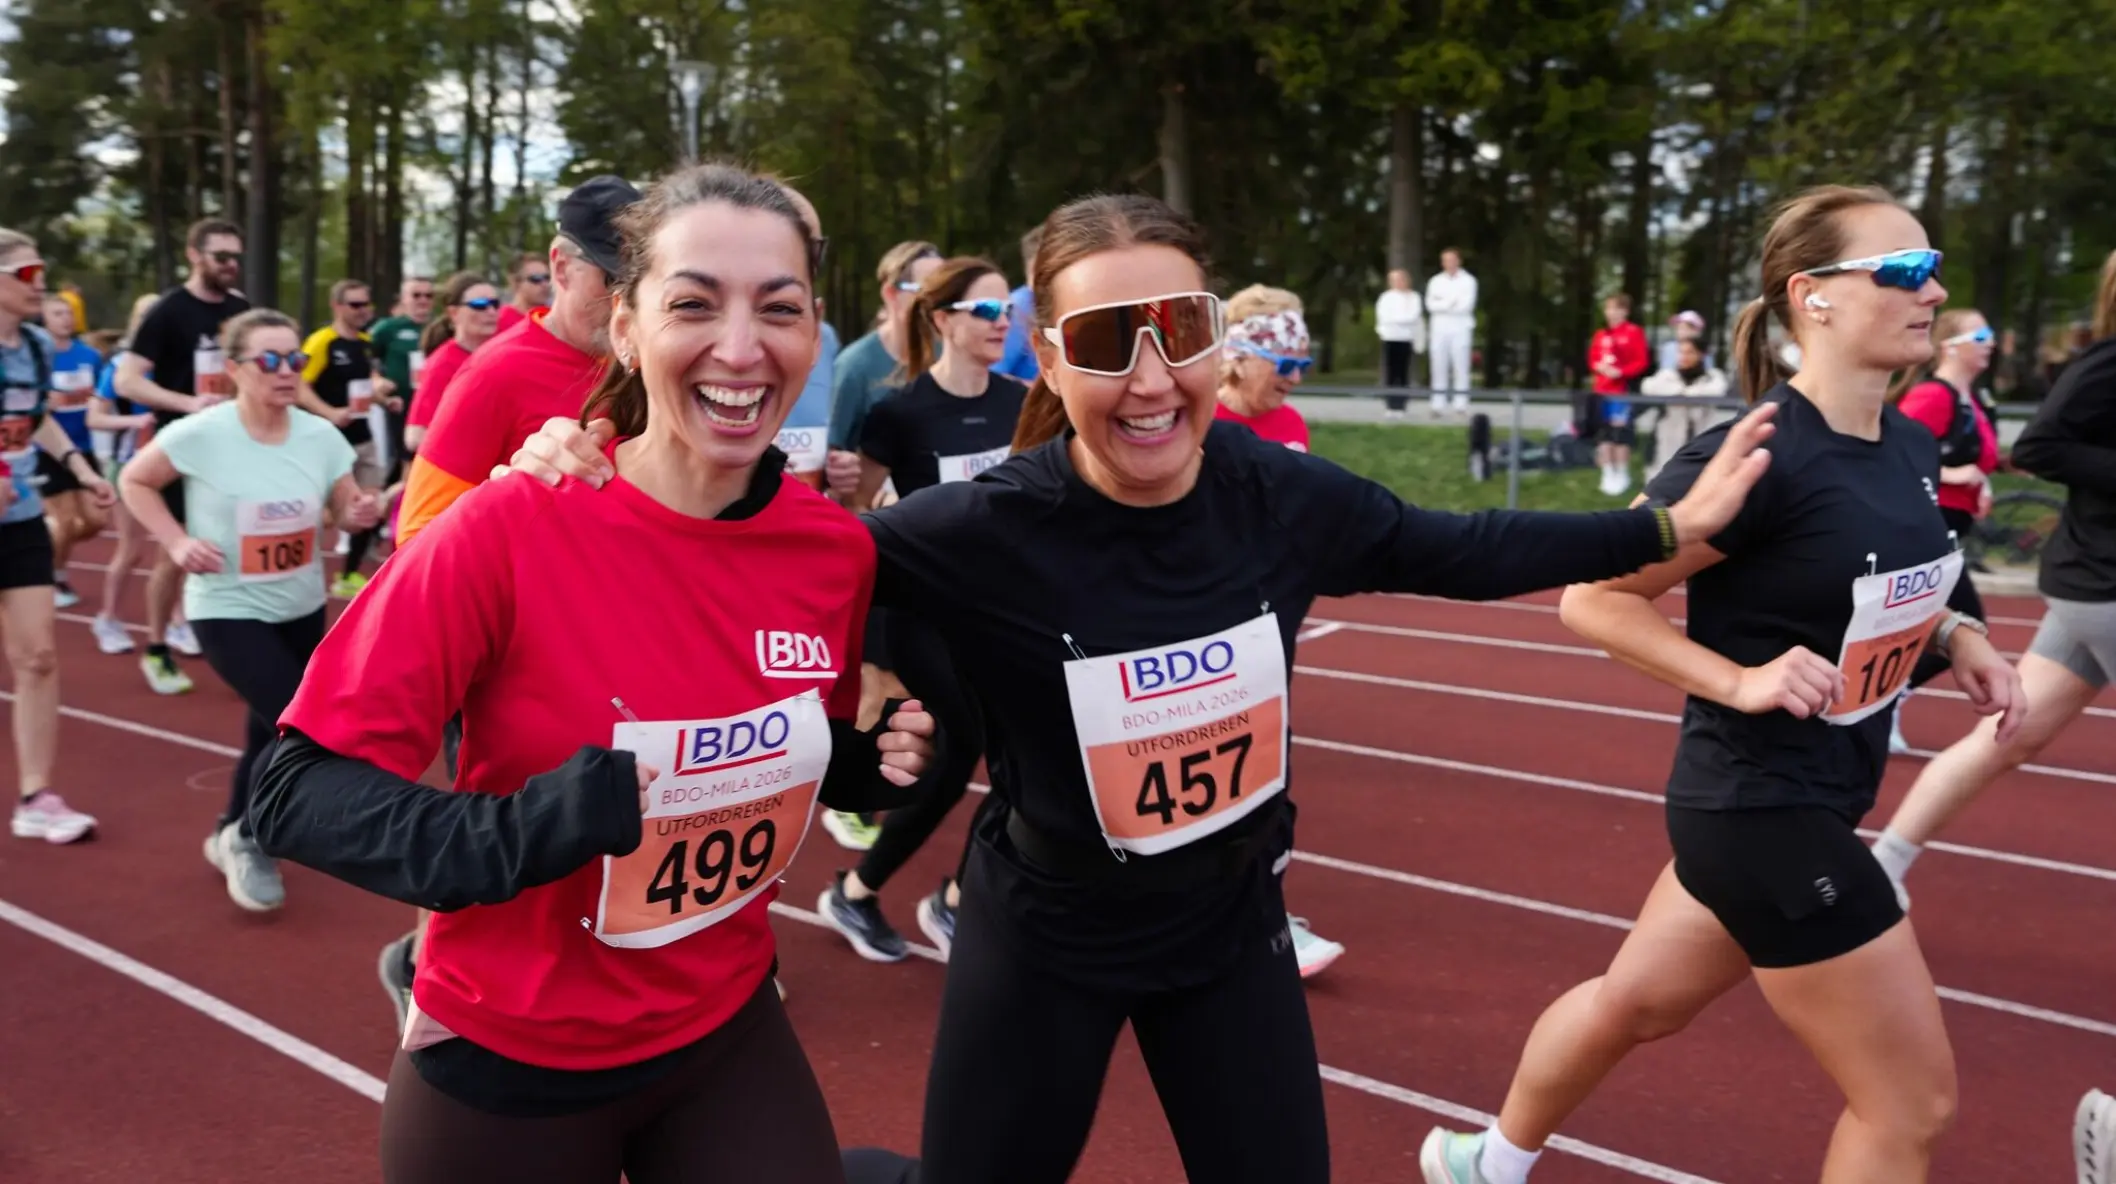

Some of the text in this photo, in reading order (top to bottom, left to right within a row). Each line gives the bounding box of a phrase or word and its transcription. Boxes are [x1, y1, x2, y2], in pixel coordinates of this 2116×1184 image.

[256, 539, 305, 572] 108
[1895, 564, 1942, 601] BDO
[768, 630, 832, 669] BDO
[1132, 640, 1234, 692] BDO
[1859, 637, 1922, 705] 107
[1121, 686, 1250, 731] BDO-MILA 2026
[691, 710, 790, 764] BDO
[1126, 711, 1250, 758] UTFORDREREN
[660, 765, 793, 805] BDO-MILA 2026
[1135, 732, 1254, 826] 457
[655, 794, 785, 837] UTFORDREREN
[645, 818, 777, 915] 499
